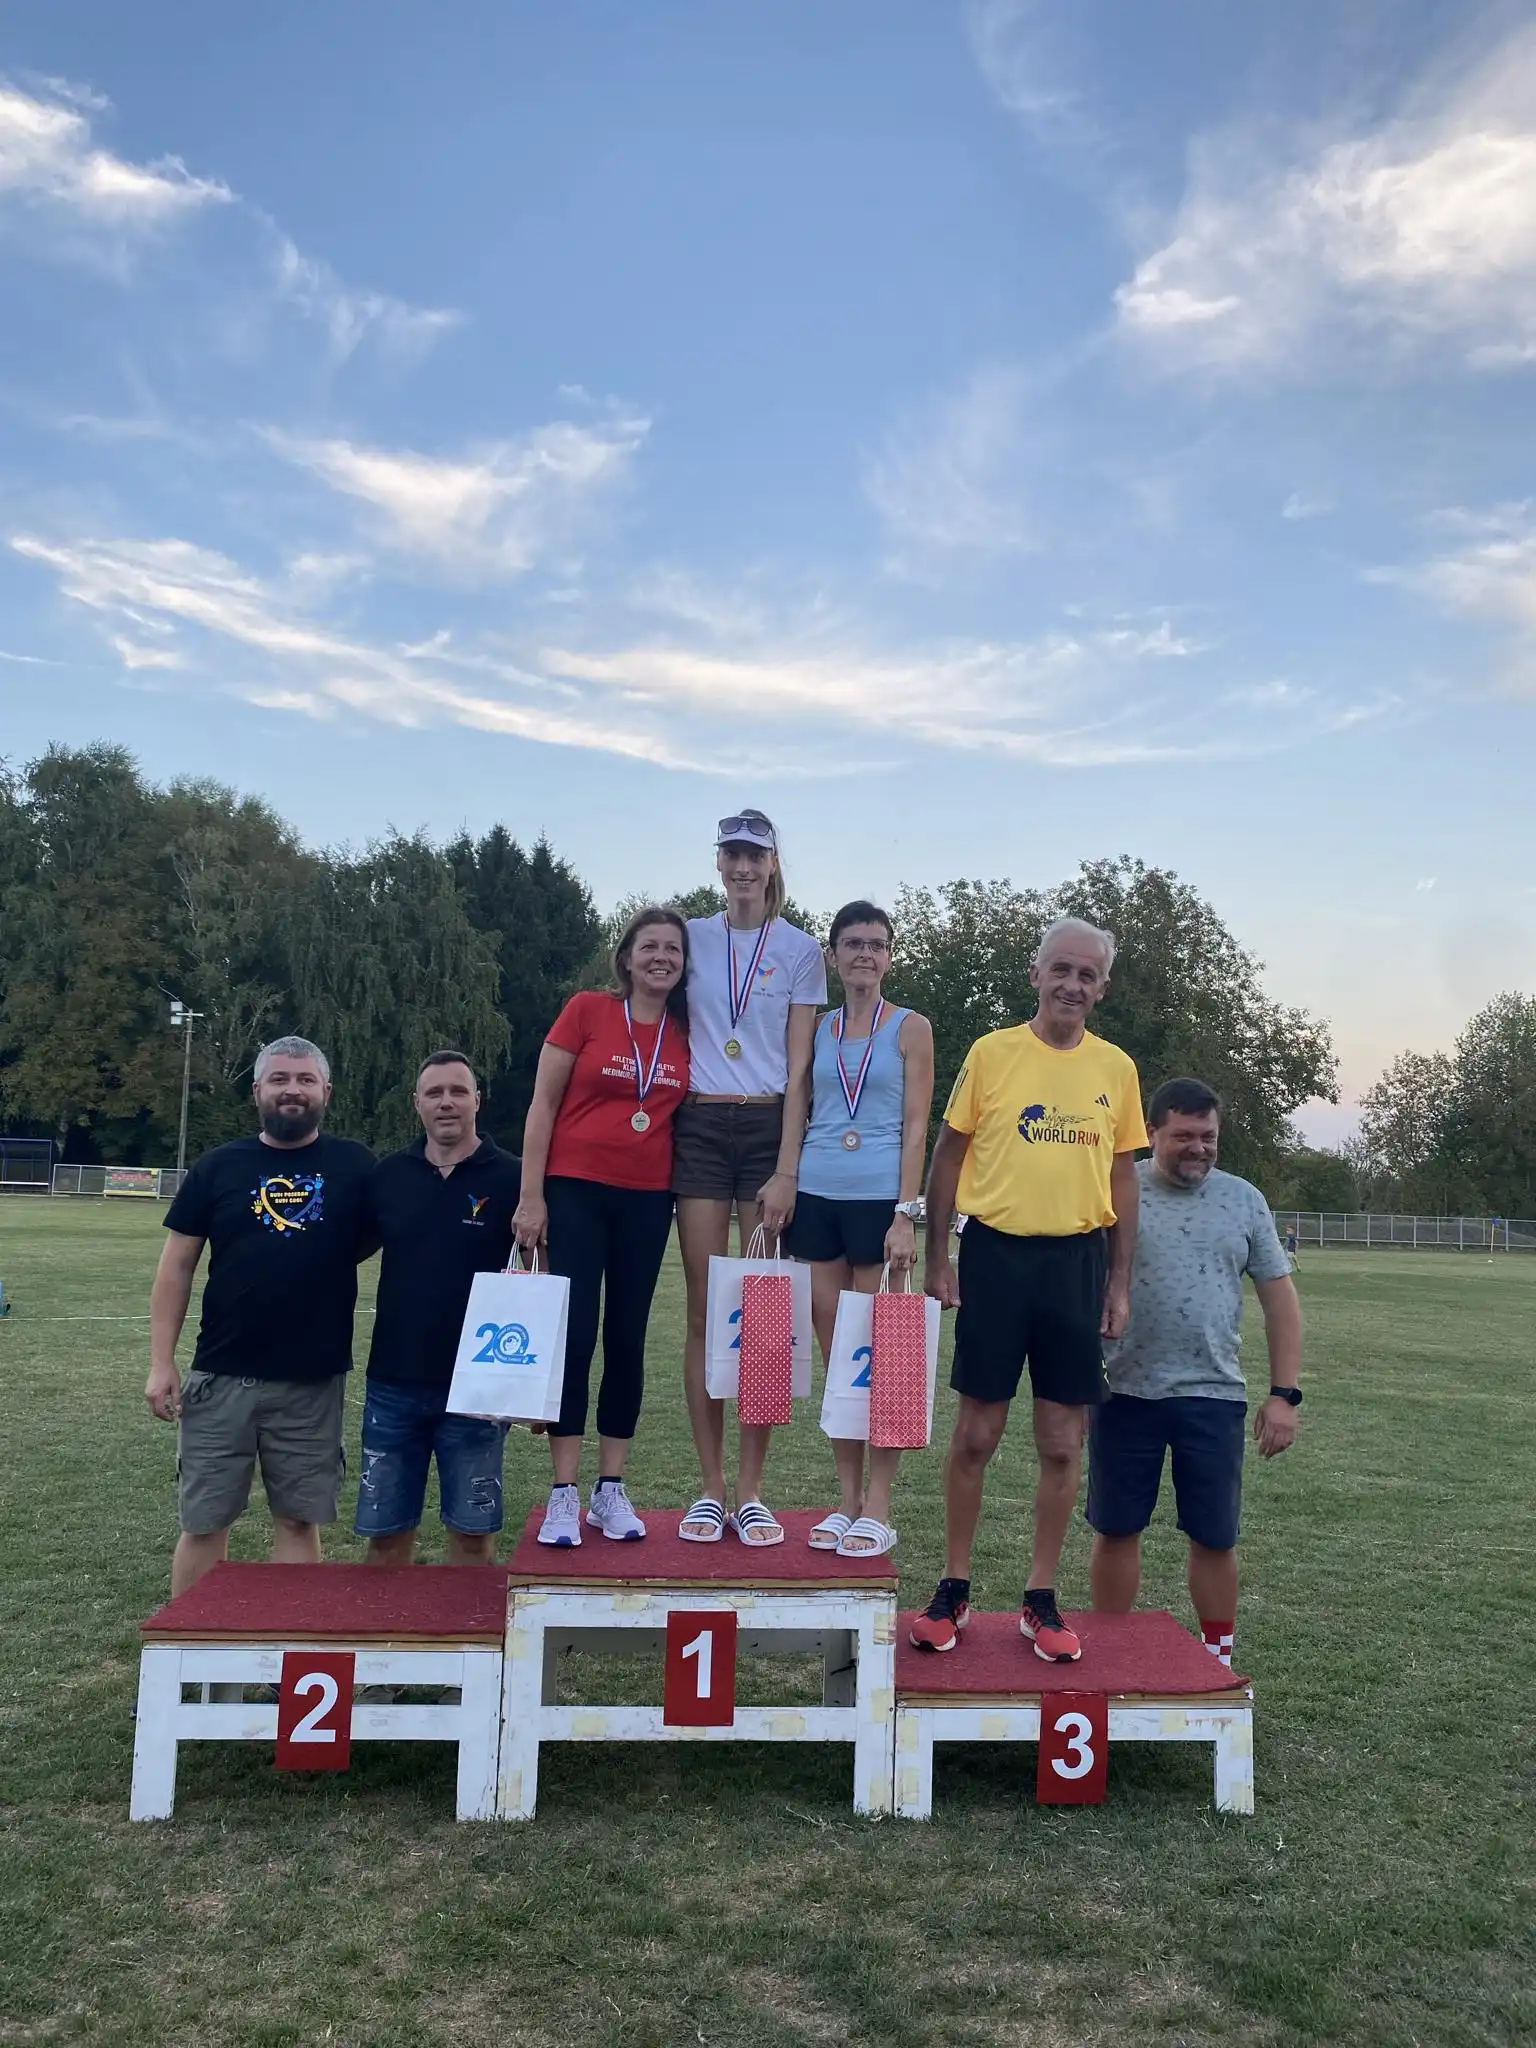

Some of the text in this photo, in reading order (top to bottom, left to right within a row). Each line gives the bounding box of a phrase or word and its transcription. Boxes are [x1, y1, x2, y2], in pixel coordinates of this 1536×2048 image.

[612, 1055, 636, 1064] ATLETSK
[657, 1063, 675, 1072] HLETIC
[851, 1346, 873, 1387] 2
[682, 1630, 712, 1698] 1
[289, 1672, 339, 1742] 2
[1051, 1712, 1094, 1779] 3
